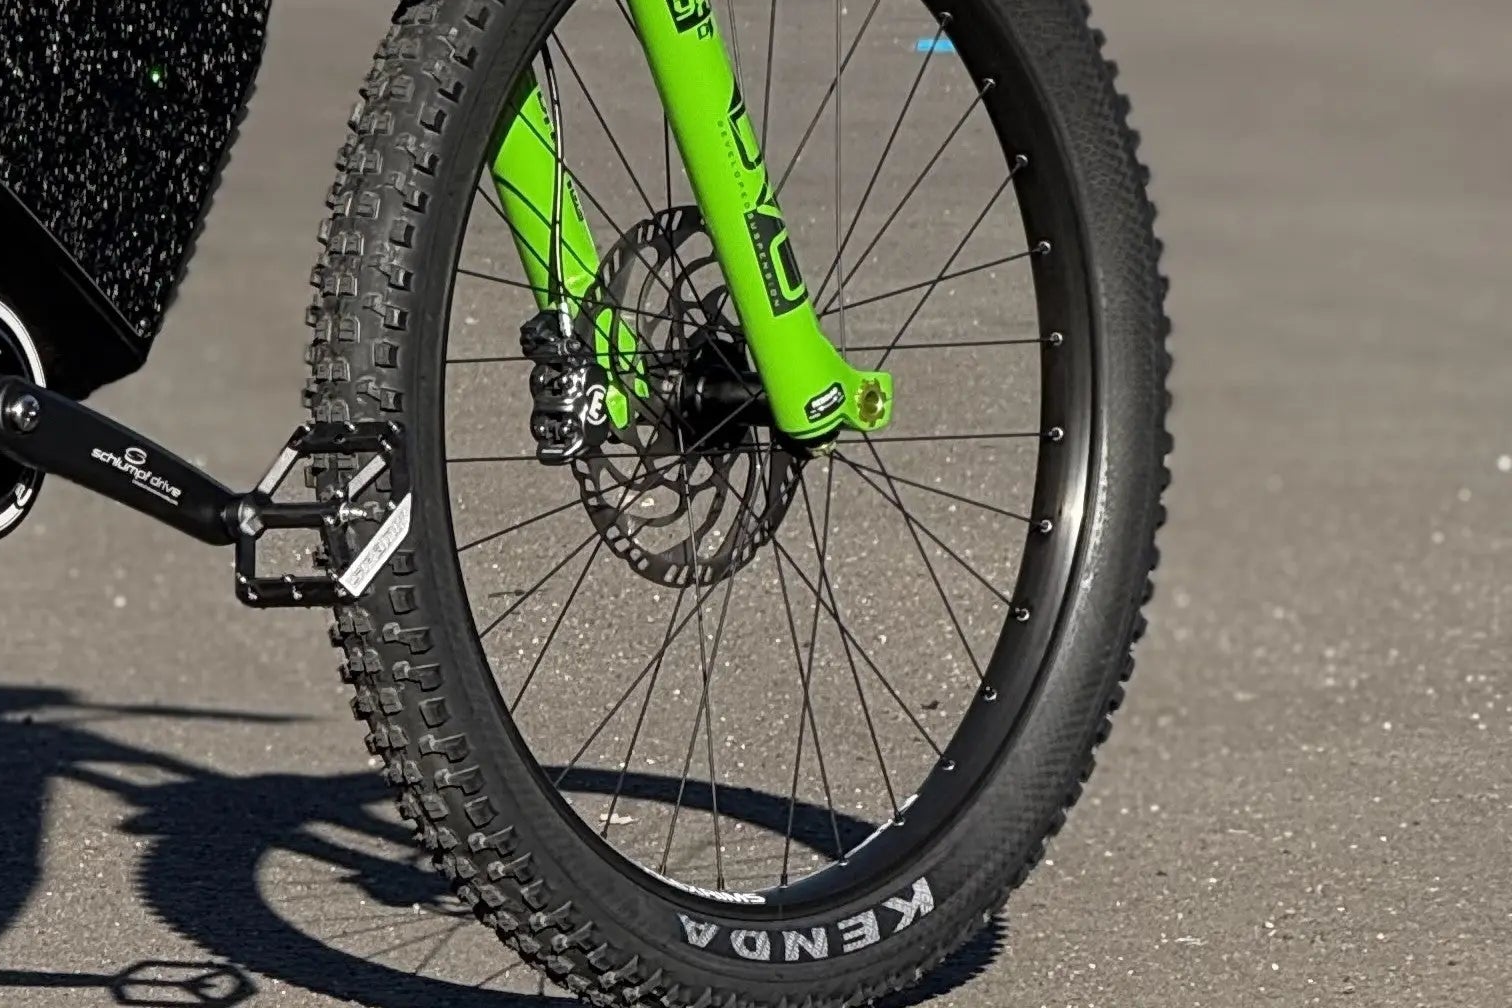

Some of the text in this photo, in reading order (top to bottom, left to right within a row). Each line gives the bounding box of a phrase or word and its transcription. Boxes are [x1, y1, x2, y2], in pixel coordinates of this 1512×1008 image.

[91, 447, 152, 482] schlumpf
[150, 476, 182, 499] drive
[677, 876, 935, 962] KENDA
